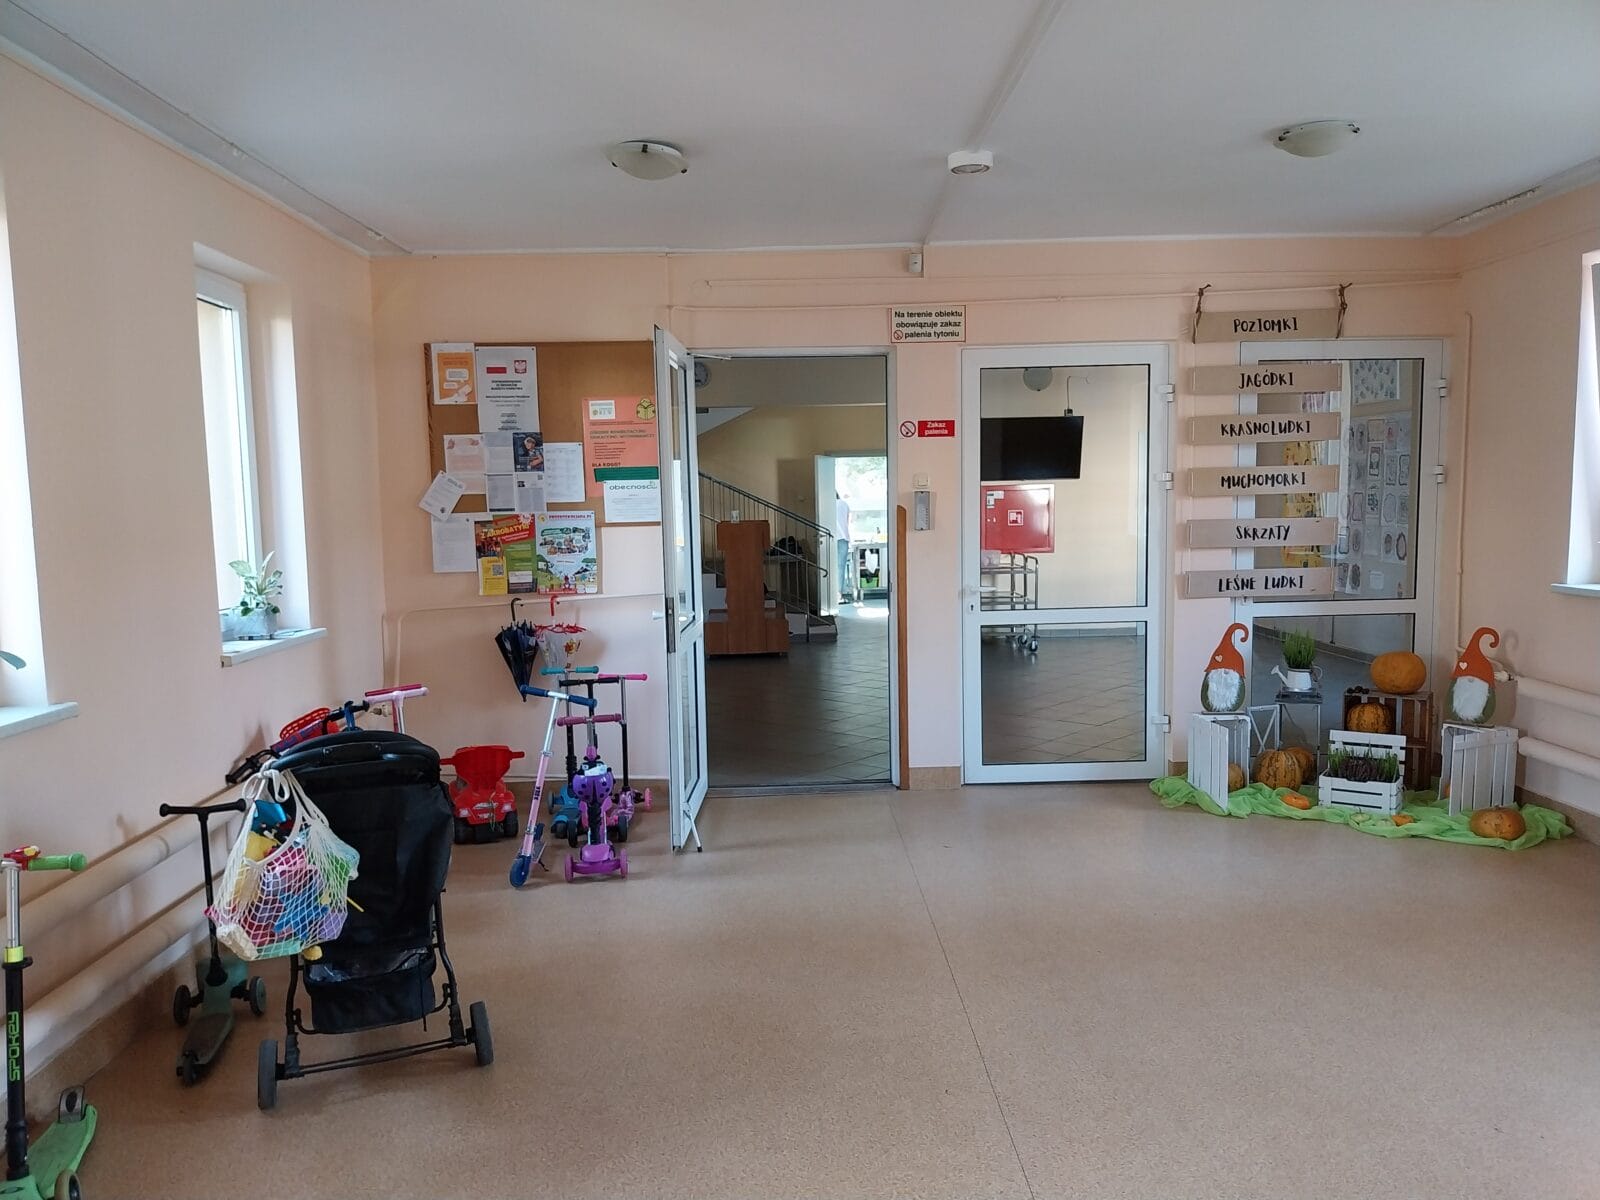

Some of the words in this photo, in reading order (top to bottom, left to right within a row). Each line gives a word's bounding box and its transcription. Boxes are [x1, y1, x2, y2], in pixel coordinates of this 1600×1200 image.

[907, 310, 933, 318] terenie
[934, 310, 963, 318] obiektu
[895, 320, 939, 329] obowiązuje
[940, 320, 962, 328] zakaz
[1233, 317, 1298, 333] POZIOMKI
[904, 330, 932, 339] palenia
[933, 330, 960, 339] tytoniu
[1238, 369, 1294, 389] JAGÓDKI
[1220, 420, 1311, 437] KRASNOLUDKI
[1220, 472, 1306, 489] MUCHOMORKI
[1236, 525, 1290, 540] SKRZATY
[1218, 574, 1256, 592] LEŚNE
[1264, 575, 1304, 590] LUDKI
